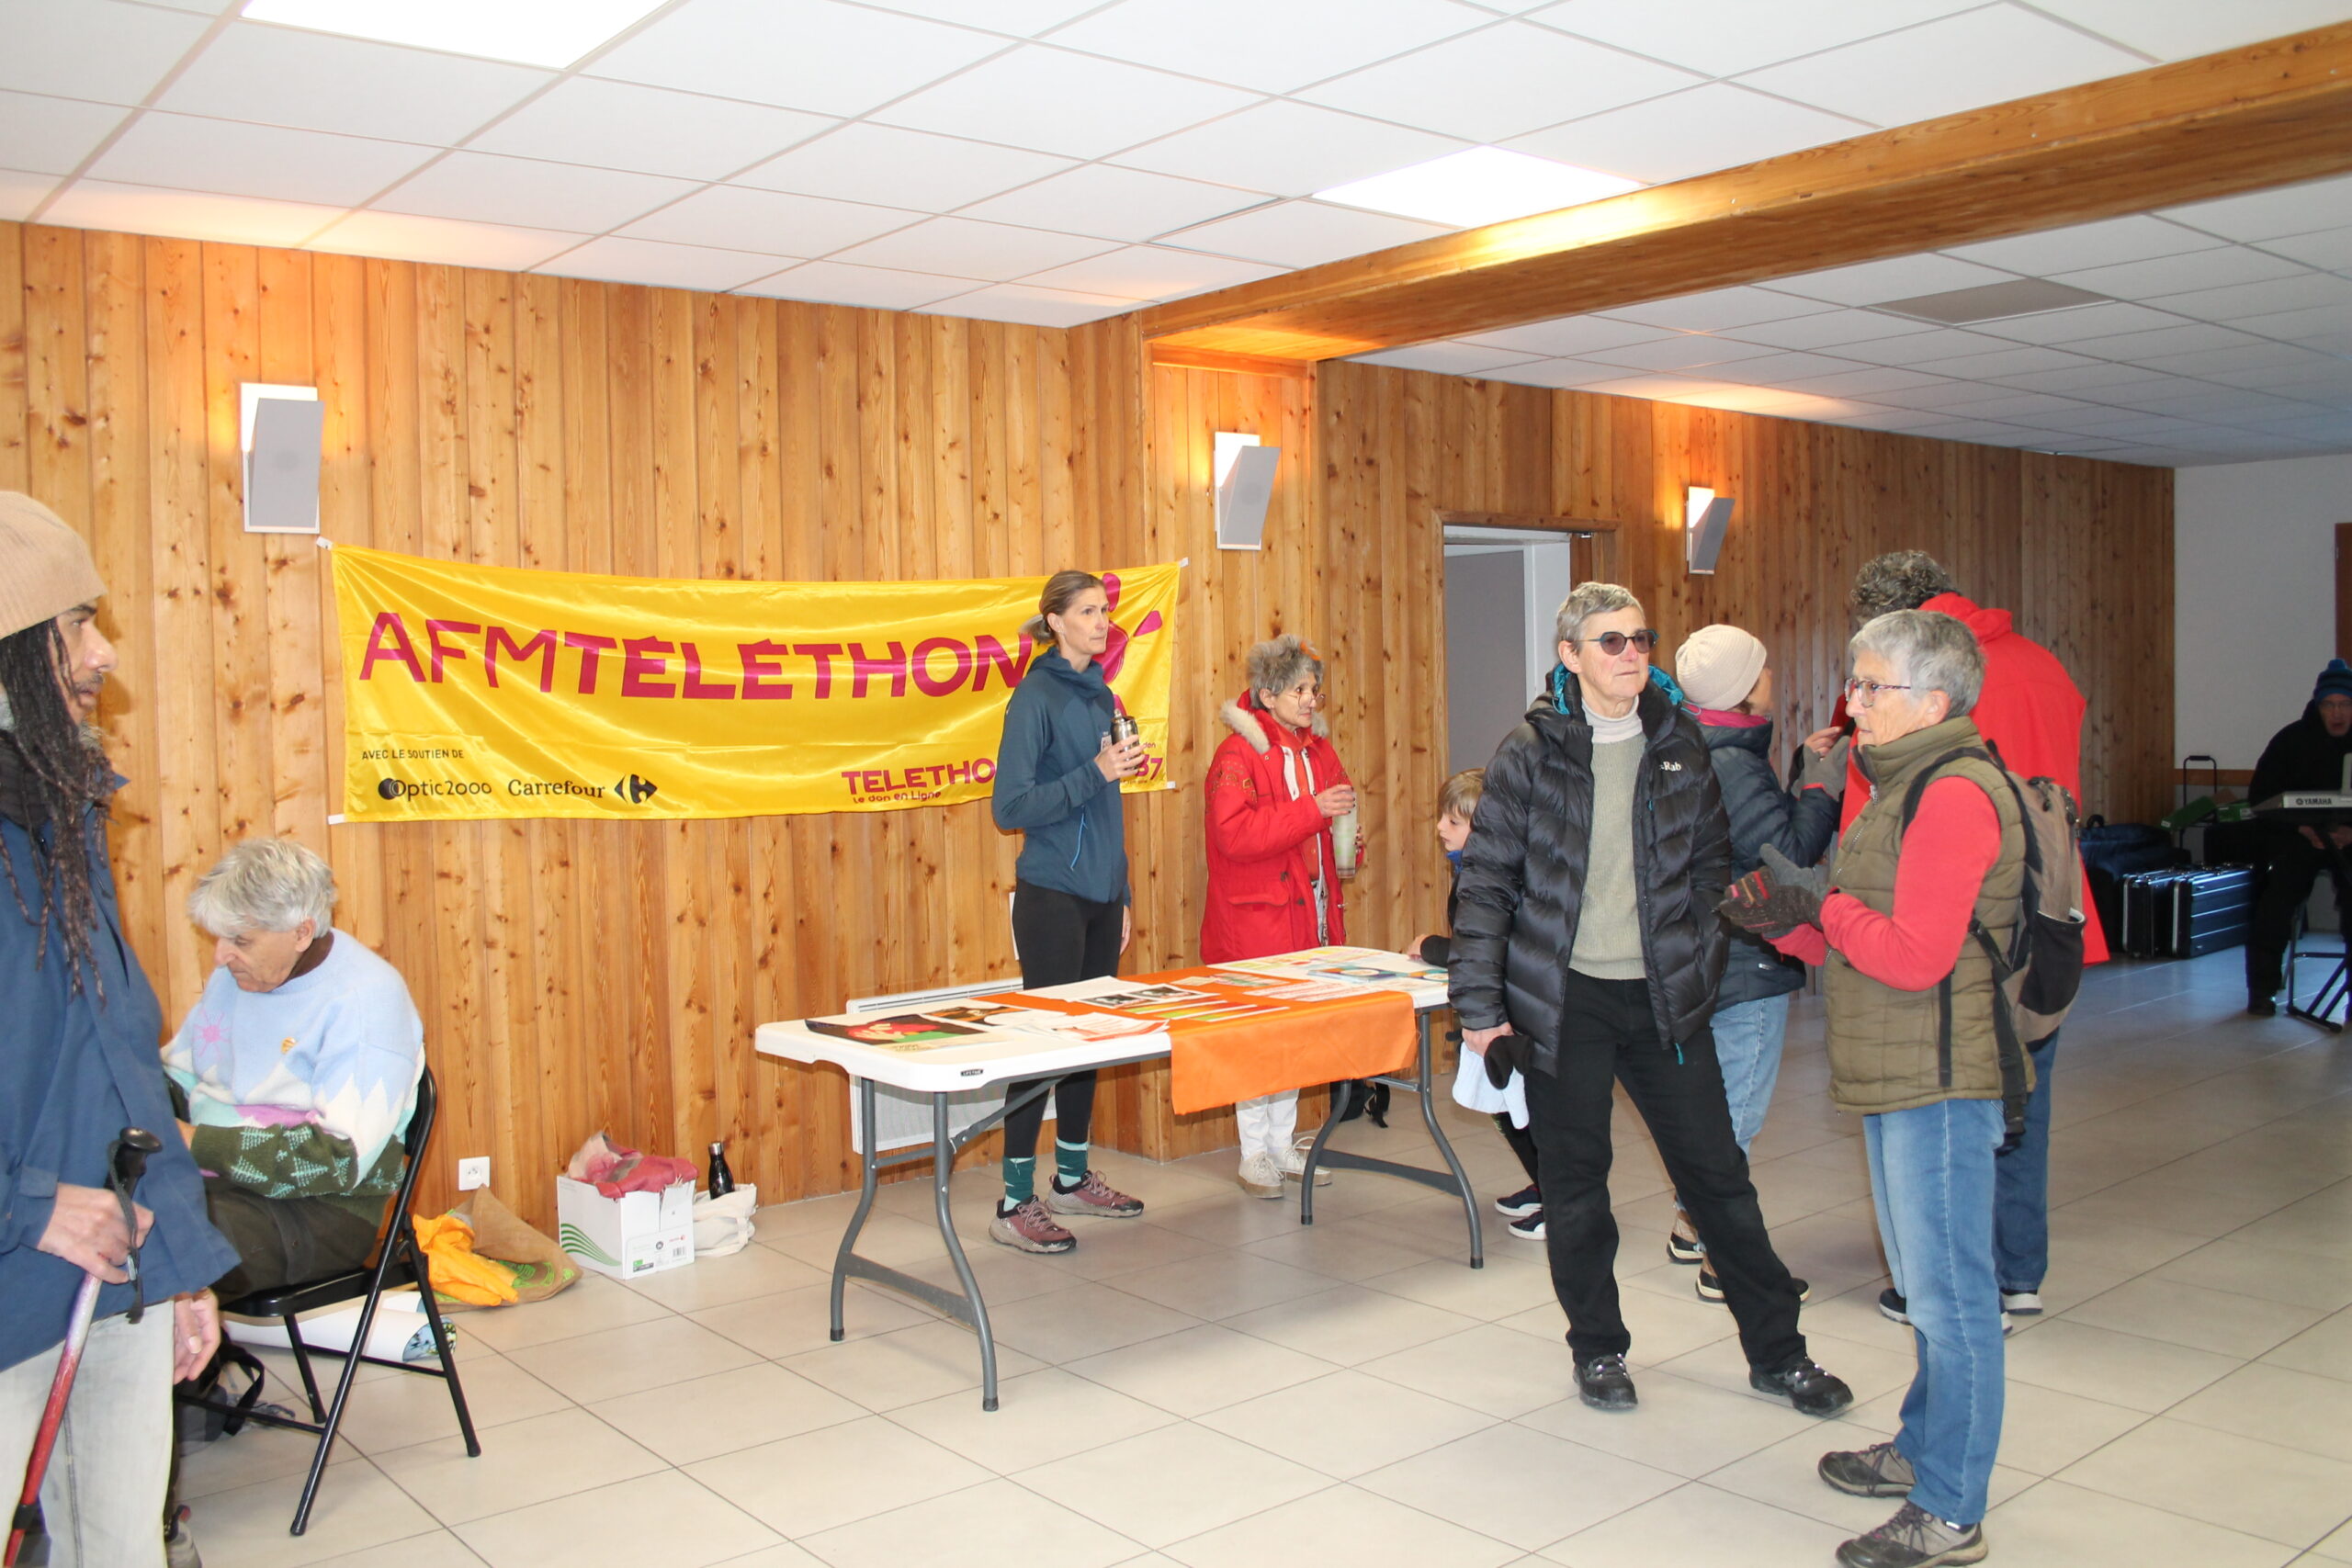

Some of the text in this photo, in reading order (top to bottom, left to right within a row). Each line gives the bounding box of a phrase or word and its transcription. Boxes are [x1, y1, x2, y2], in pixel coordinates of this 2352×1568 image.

[362, 749, 465, 760] AVEC LE SOUTIEN DE
[1663, 761, 1682, 772] Rab
[842, 758, 997, 795] TELETHO
[508, 779, 605, 798] Carrefour
[868, 795, 891, 803] don
